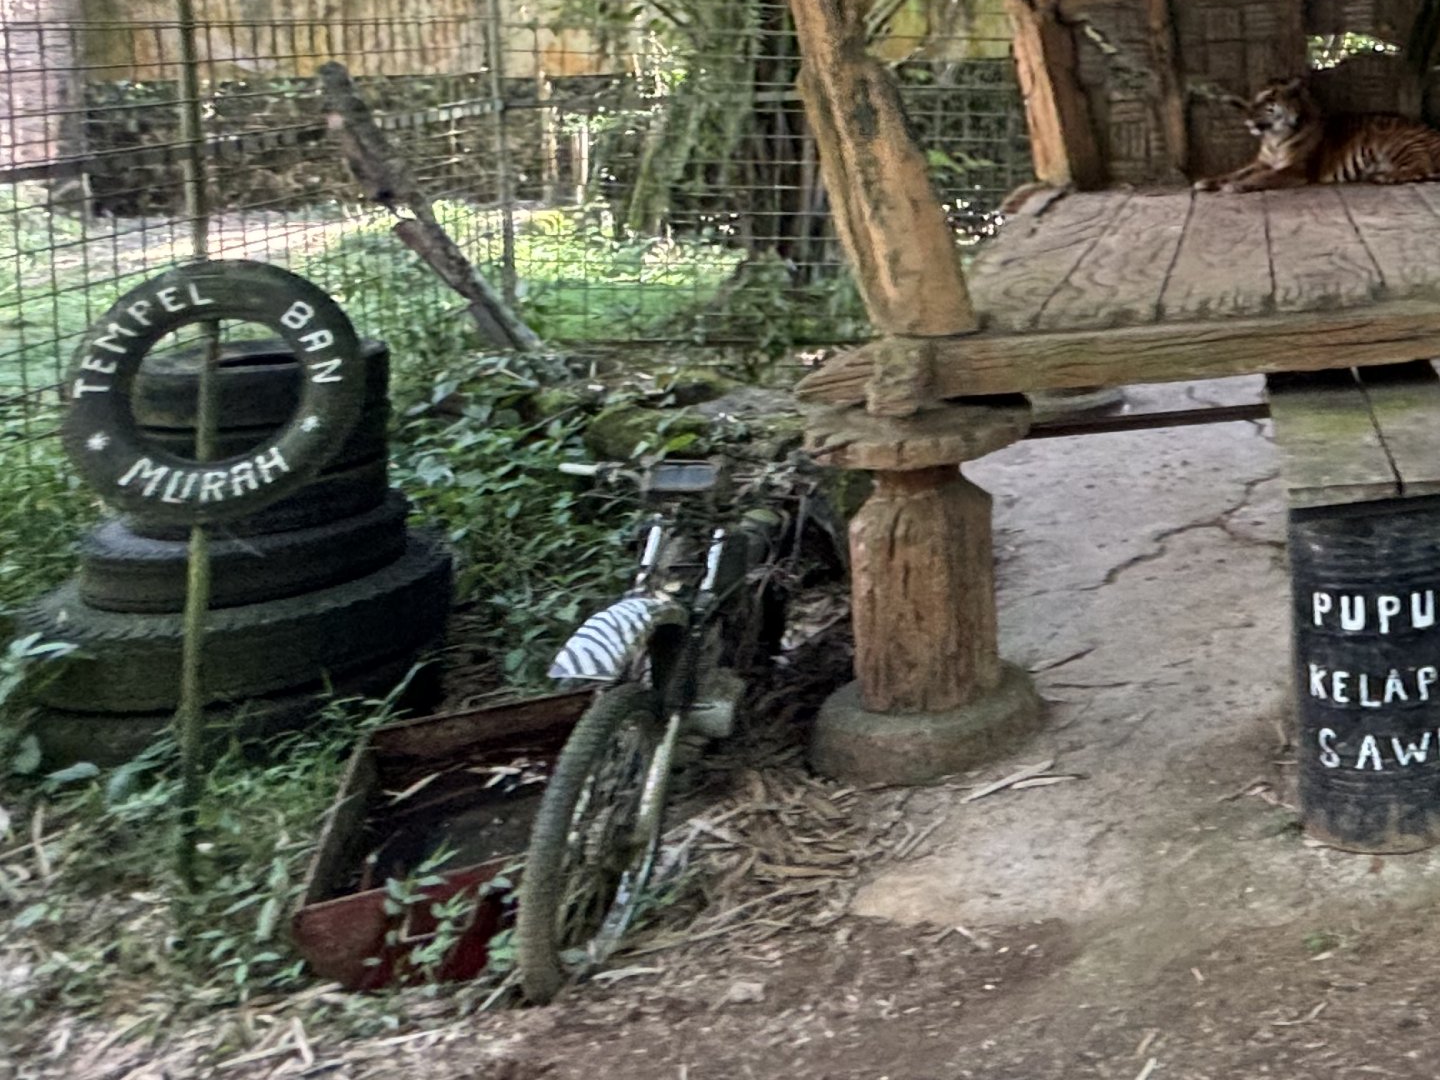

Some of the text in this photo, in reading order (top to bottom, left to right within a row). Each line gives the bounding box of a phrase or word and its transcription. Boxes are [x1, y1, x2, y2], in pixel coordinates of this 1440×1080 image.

[73, 282, 344, 399] TEMPEL BAN
[117, 447, 290, 504] MURAH
